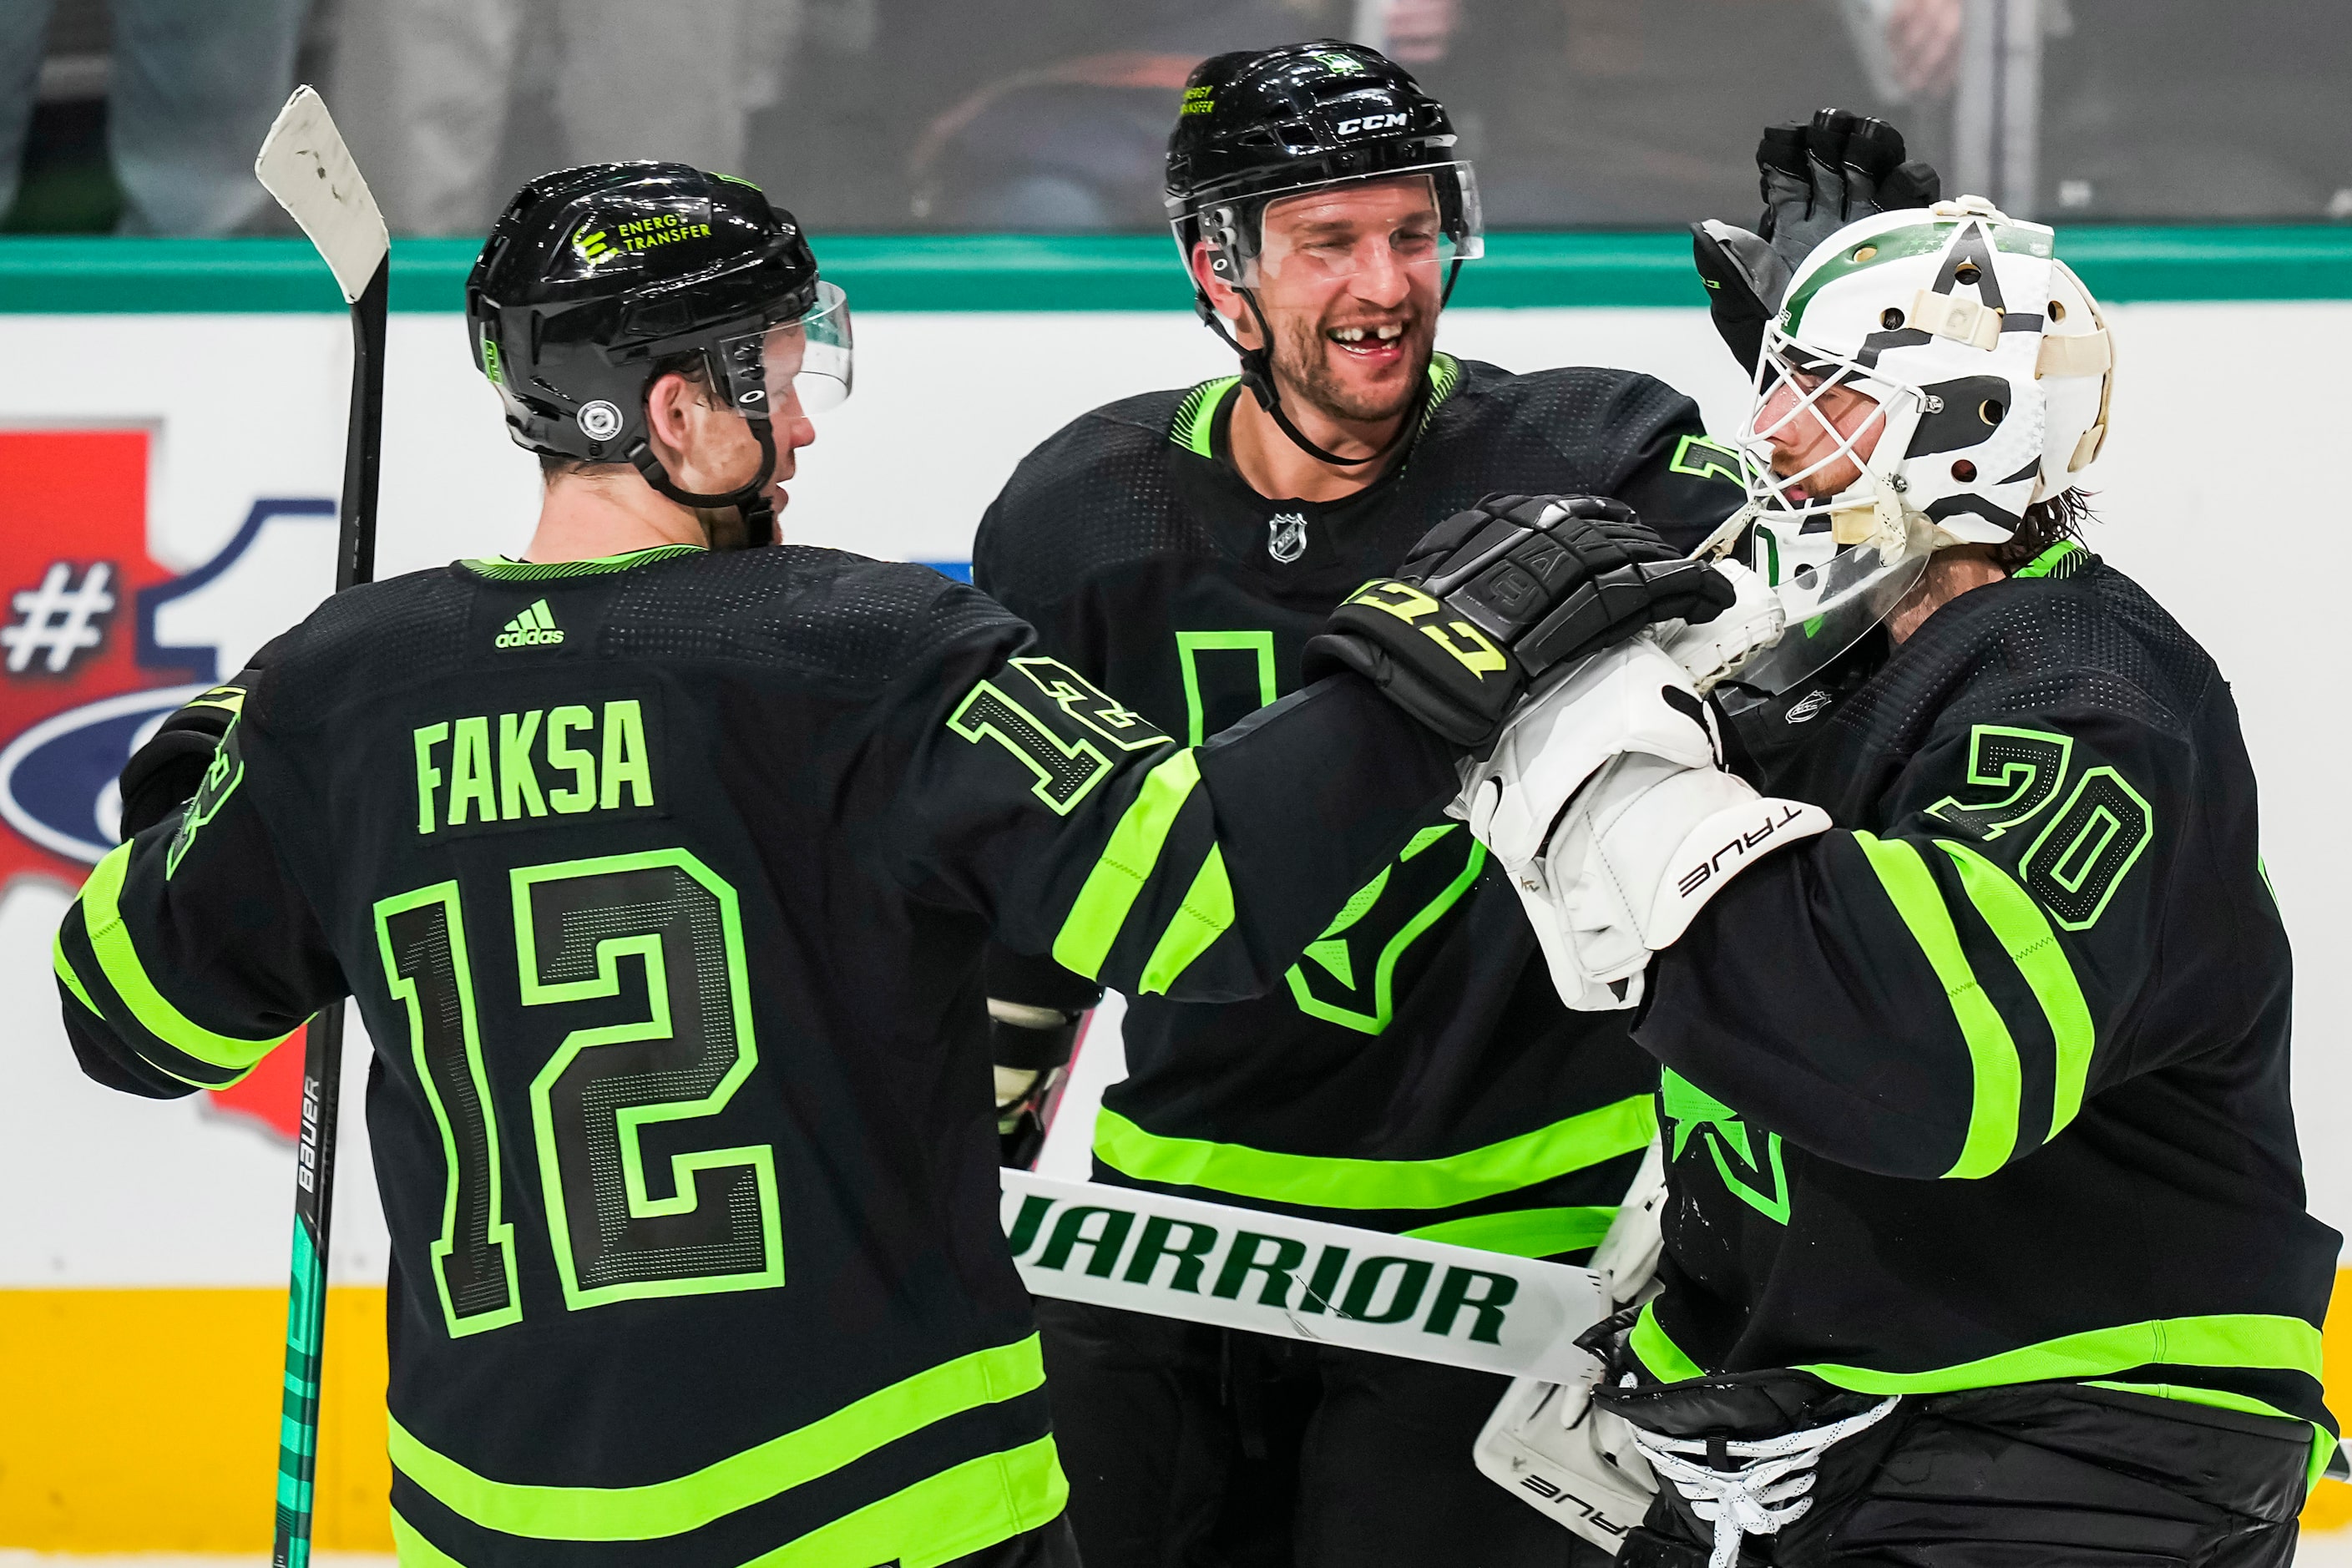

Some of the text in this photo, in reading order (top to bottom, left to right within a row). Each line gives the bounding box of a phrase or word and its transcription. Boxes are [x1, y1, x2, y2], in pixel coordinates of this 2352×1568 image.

[1337, 114, 1407, 135] CCM
[619, 205, 688, 236] ENERG
[624, 224, 711, 250] TRANSFER
[495, 627, 564, 648] adidas
[1337, 578, 1507, 681] CC
[413, 700, 655, 834] FAKSA
[946, 656, 1176, 817] 12
[1677, 806, 1803, 898] TRUE
[1923, 724, 2154, 932] 20
[373, 847, 786, 1339] 12
[1520, 1474, 1630, 1540] RUE
